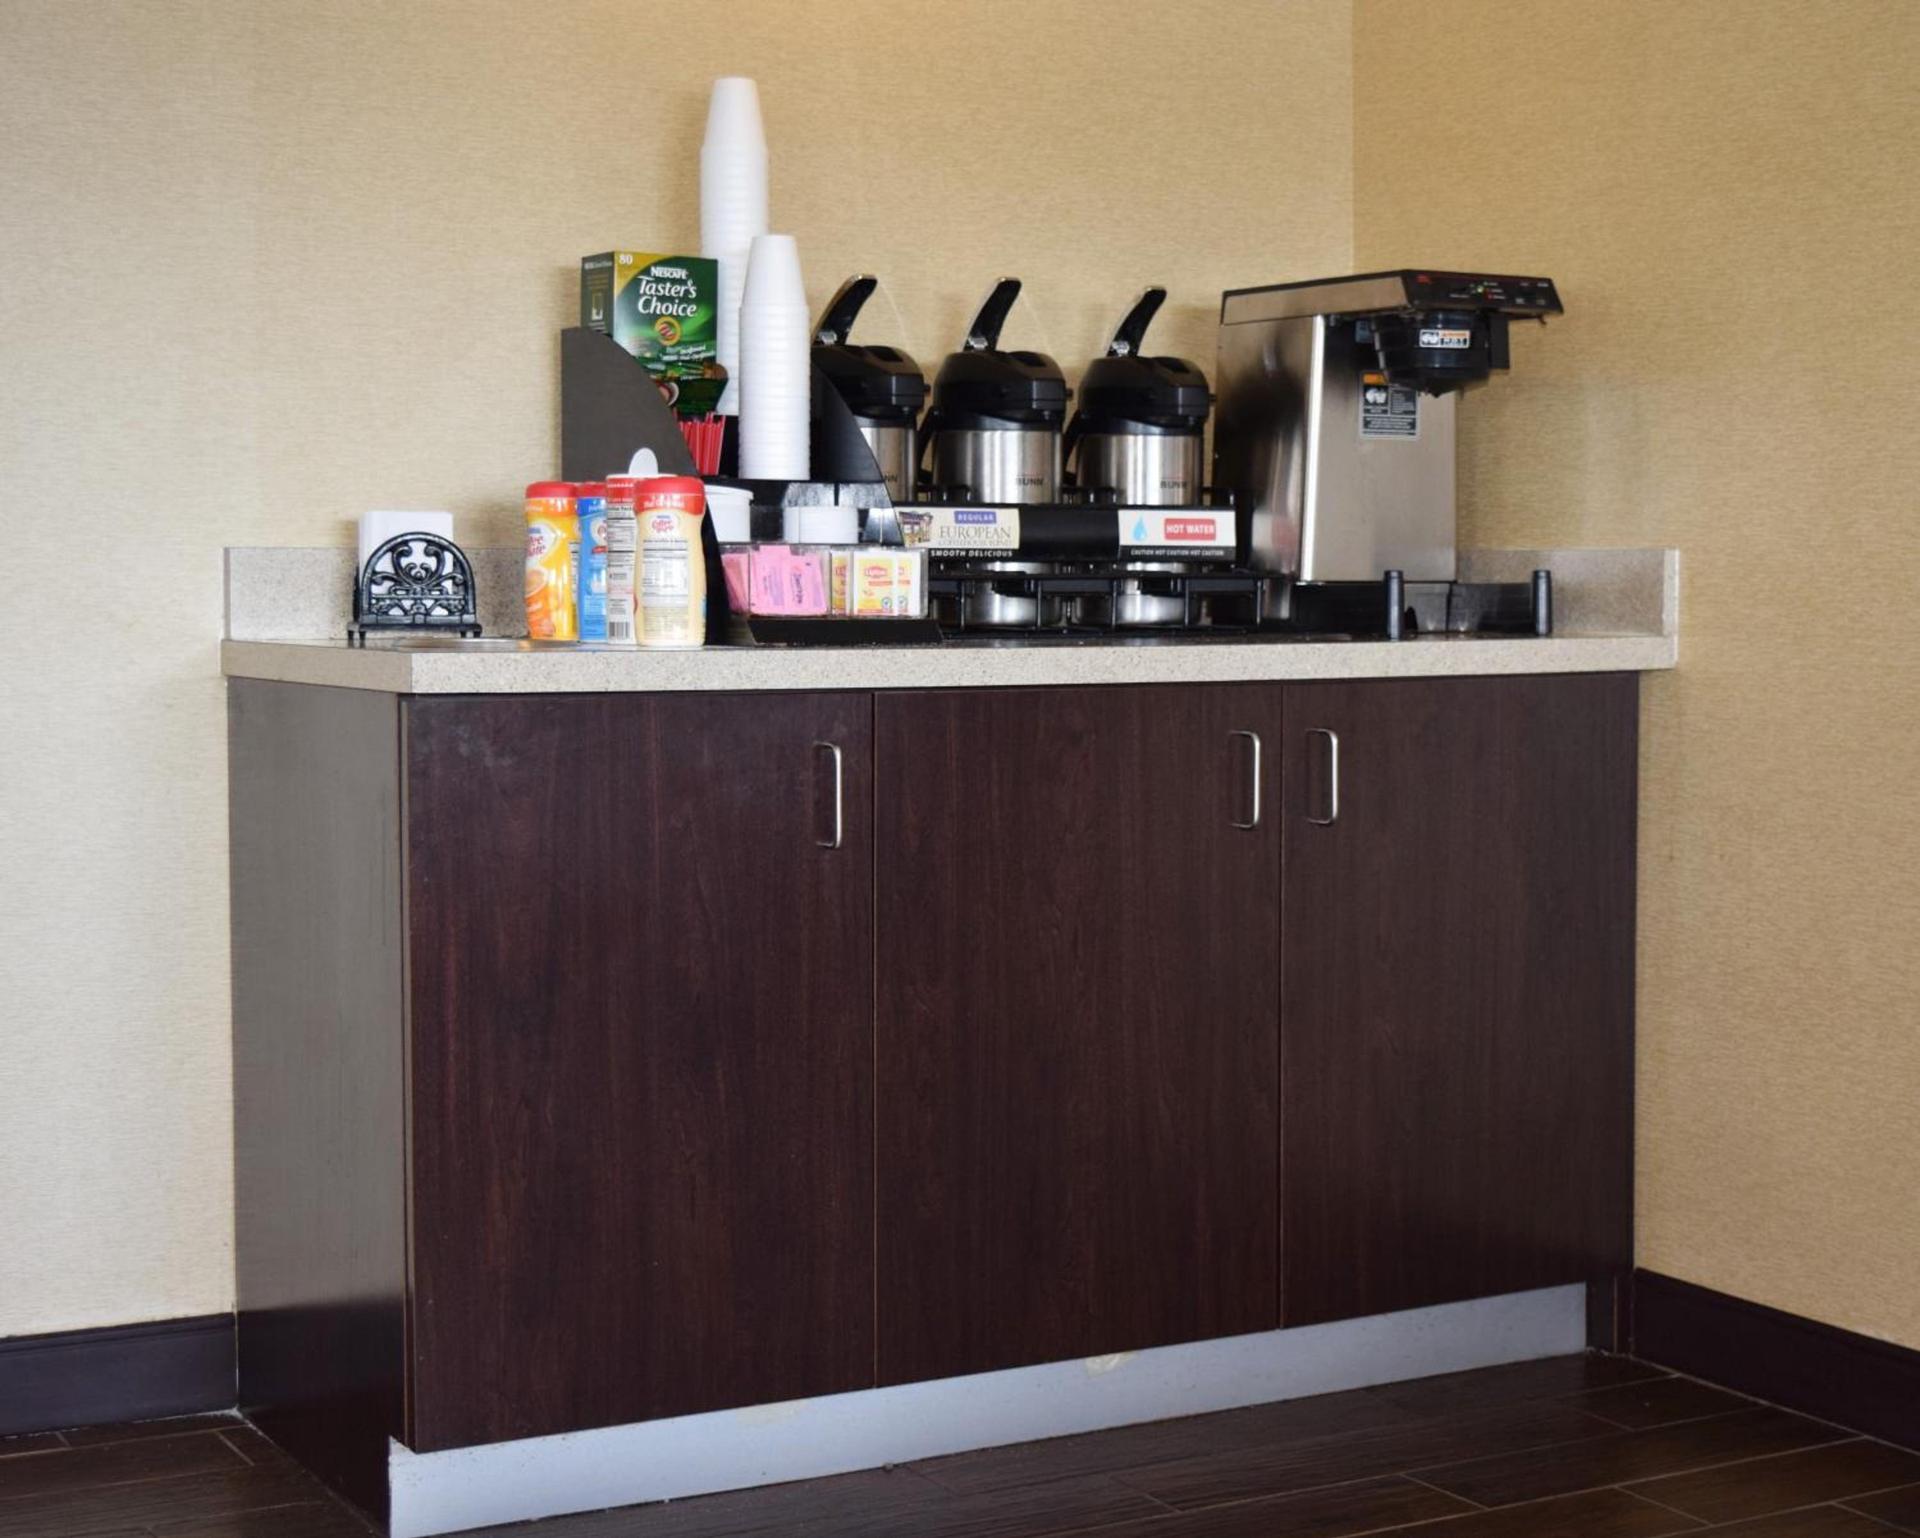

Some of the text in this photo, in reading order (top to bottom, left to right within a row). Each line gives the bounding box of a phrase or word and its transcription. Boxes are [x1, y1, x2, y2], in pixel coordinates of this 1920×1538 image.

[619, 254, 633, 265] 80
[637, 275, 697, 298] Taster's
[638, 296, 697, 317] Choice
[957, 514, 994, 522] REGULAR
[939, 526, 1012, 539] EUROPEAN
[1166, 524, 1214, 534] HOT WATER
